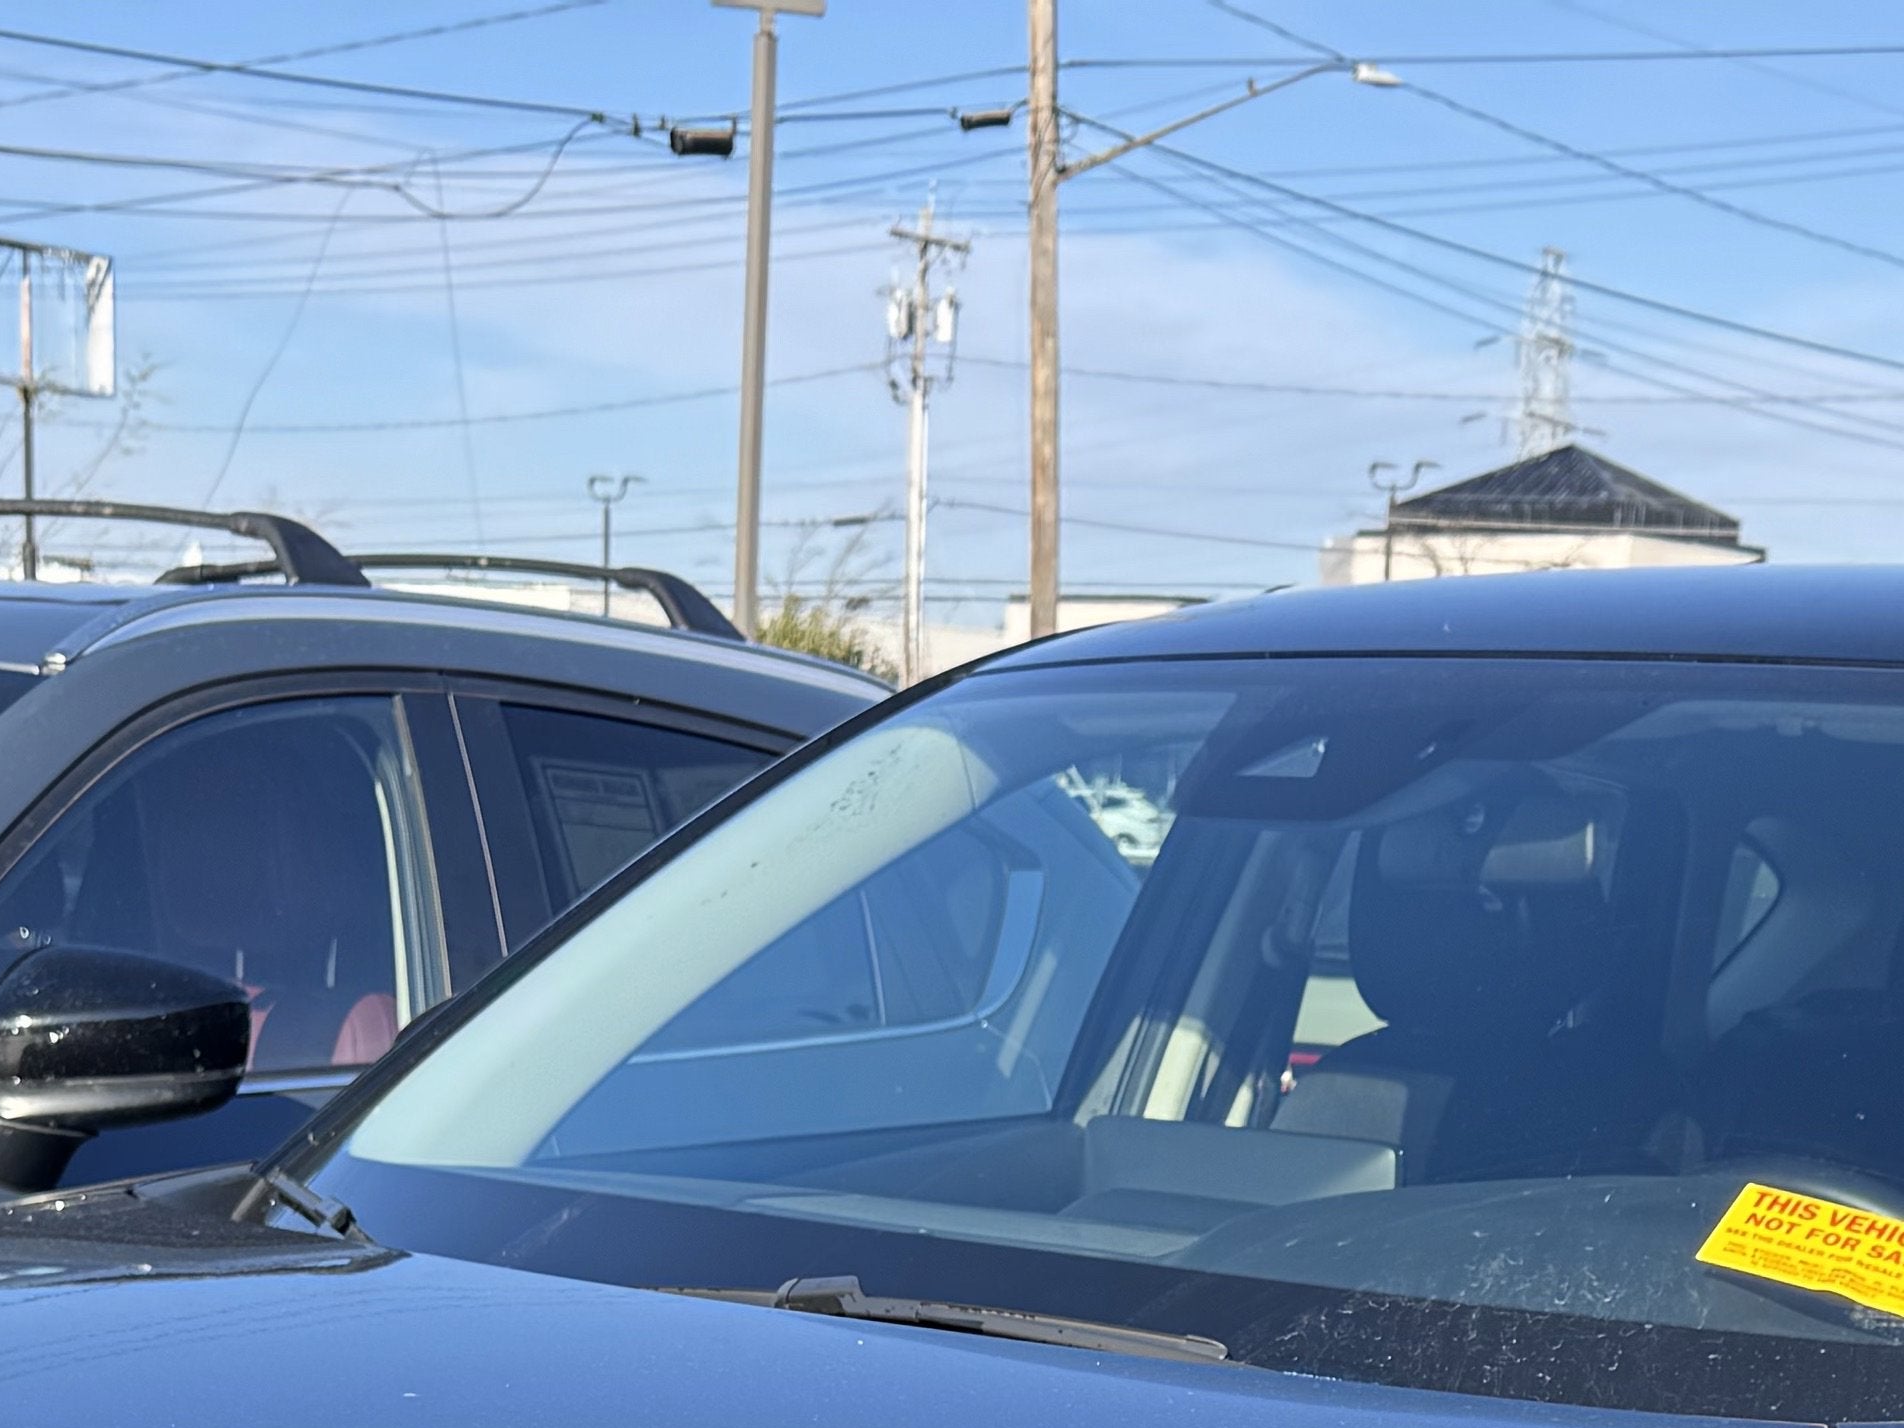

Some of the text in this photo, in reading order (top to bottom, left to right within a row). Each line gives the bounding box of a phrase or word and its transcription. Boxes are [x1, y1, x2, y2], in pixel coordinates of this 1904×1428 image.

[1750, 1191, 1821, 1221] THIS
[1744, 1213, 1801, 1236] NOT
[1805, 1228, 1861, 1252] FOR
